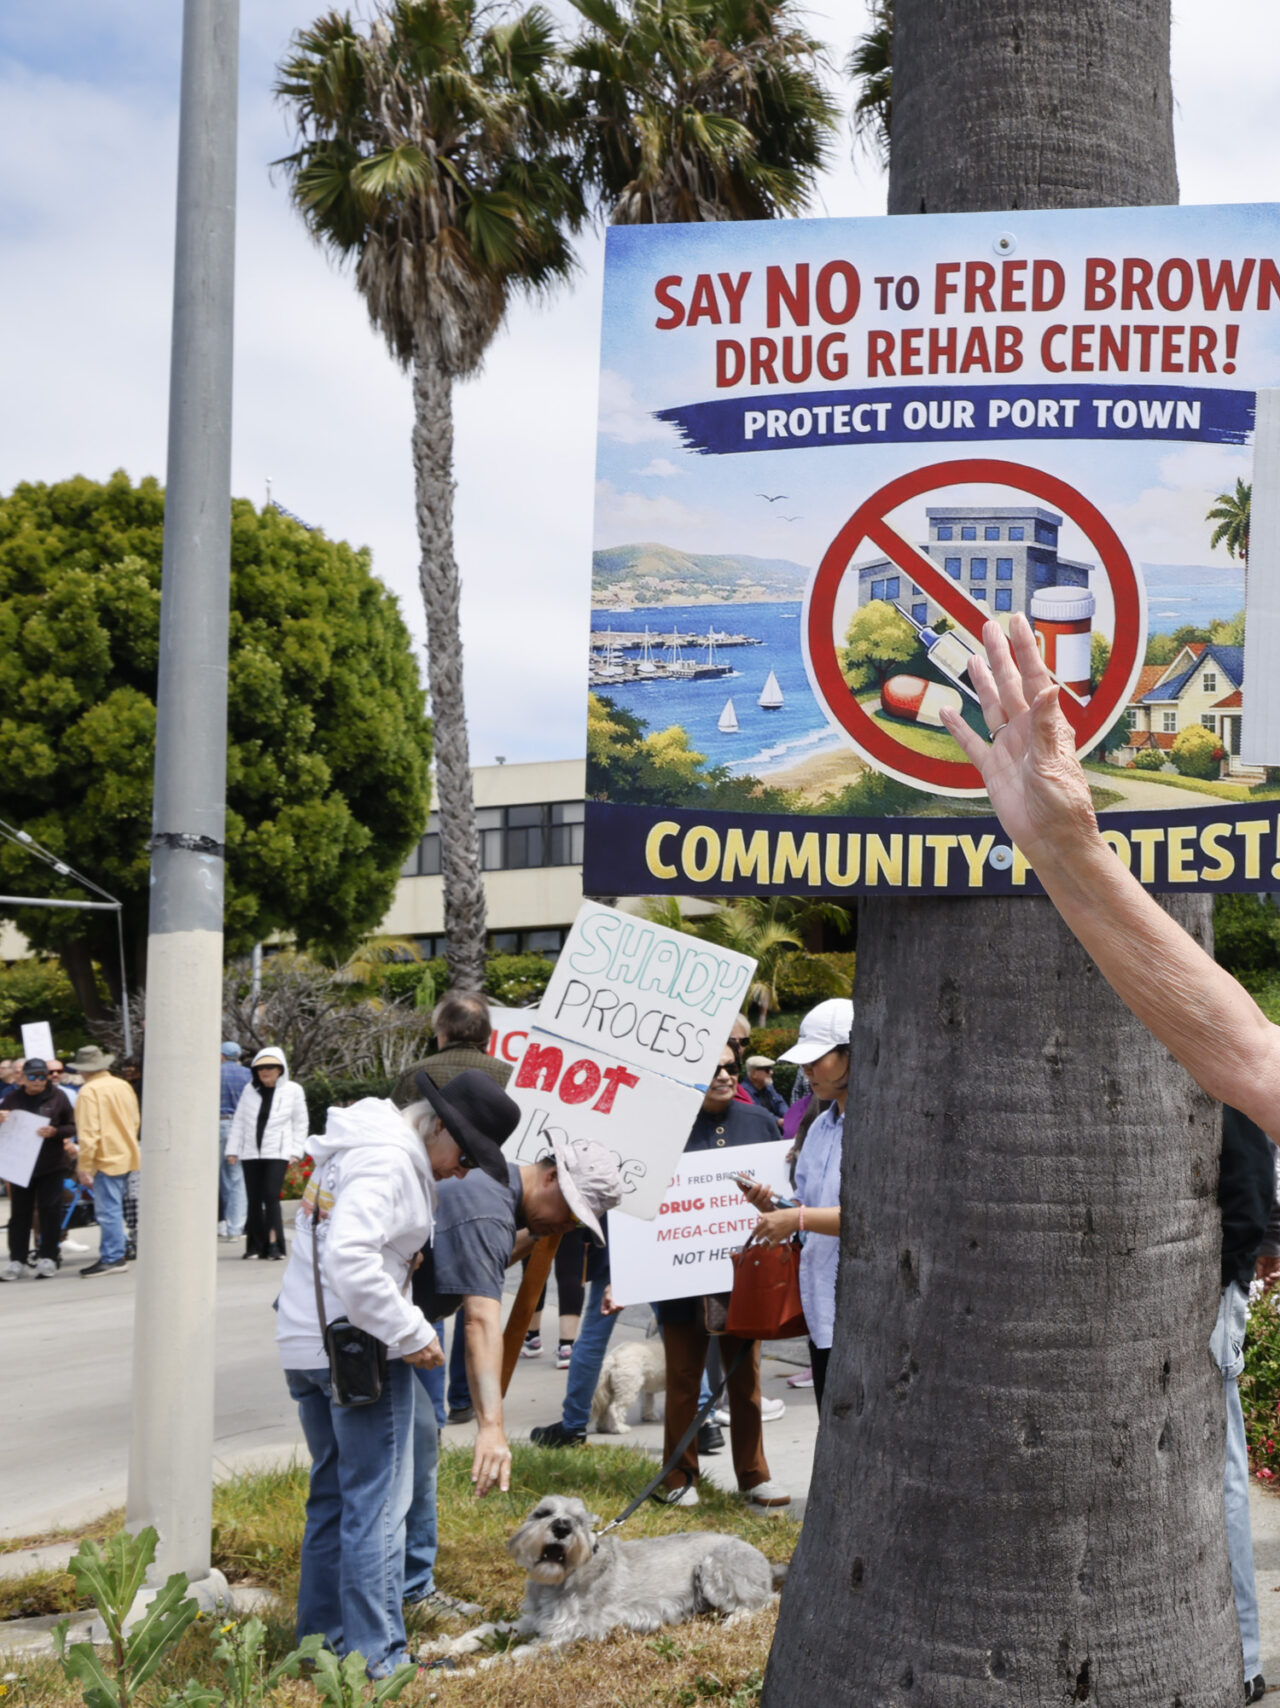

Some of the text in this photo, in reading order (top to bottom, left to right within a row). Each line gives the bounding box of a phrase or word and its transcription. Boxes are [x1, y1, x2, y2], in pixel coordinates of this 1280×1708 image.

[654, 271, 752, 330] SAY
[766, 260, 860, 329] NO
[875, 276, 920, 311] TO
[934, 259, 1066, 314] FRED
[715, 324, 1240, 388] DRUG REHAB CENTER!
[744, 399, 1202, 440] PROTECT OUR PORT TOWN
[645, 820, 995, 888] COMMUNITY
[569, 913, 749, 1016] SHADY
[555, 979, 710, 1063] PROCESS
[516, 1109, 647, 1193] he
[688, 1174, 713, 1185] FRED
[659, 1194, 751, 1215] DRUG REHA
[672, 1250, 705, 1266] NOT
